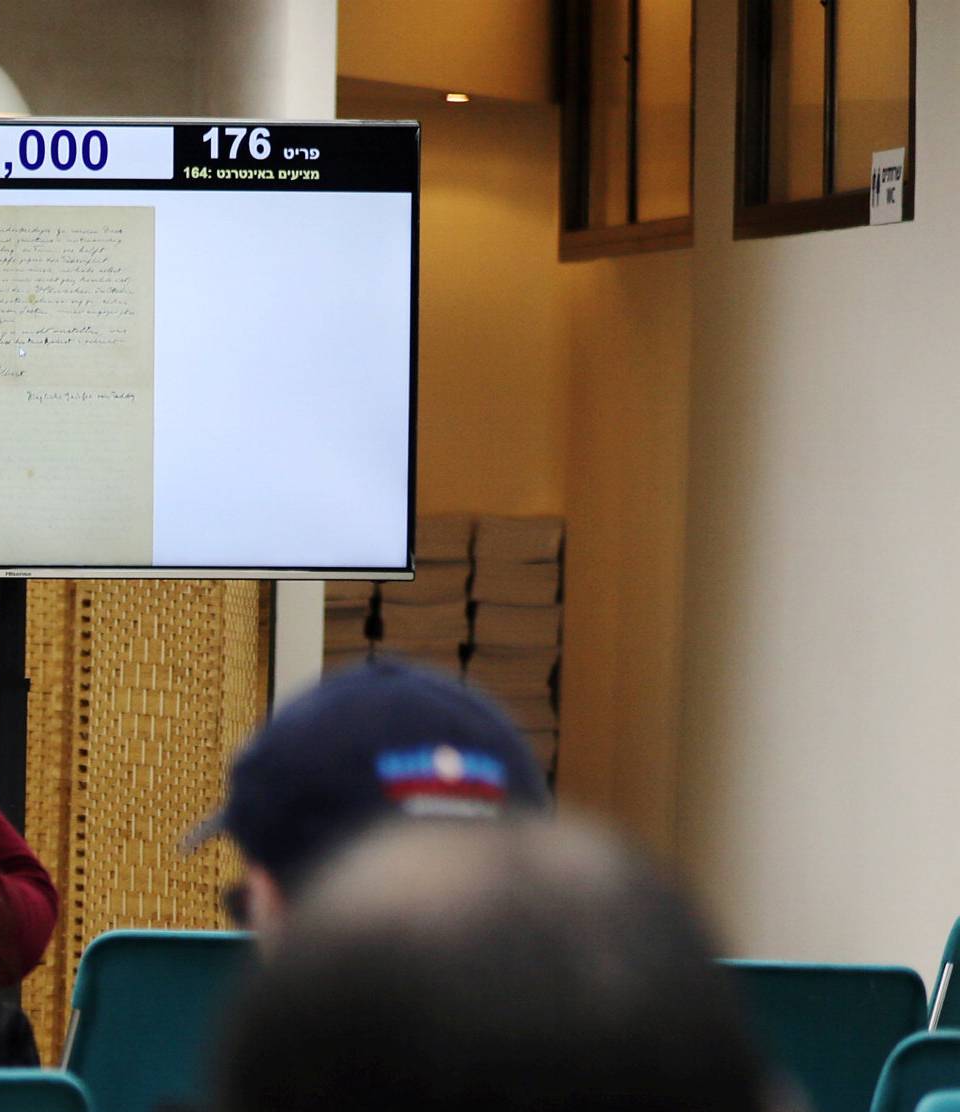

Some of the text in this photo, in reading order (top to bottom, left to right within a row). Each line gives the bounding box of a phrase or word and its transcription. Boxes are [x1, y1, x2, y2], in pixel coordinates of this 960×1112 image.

[202, 126, 320, 160] פריט 176
[216, 168, 275, 179] באינטרנט
[278, 169, 320, 181] מציעים
